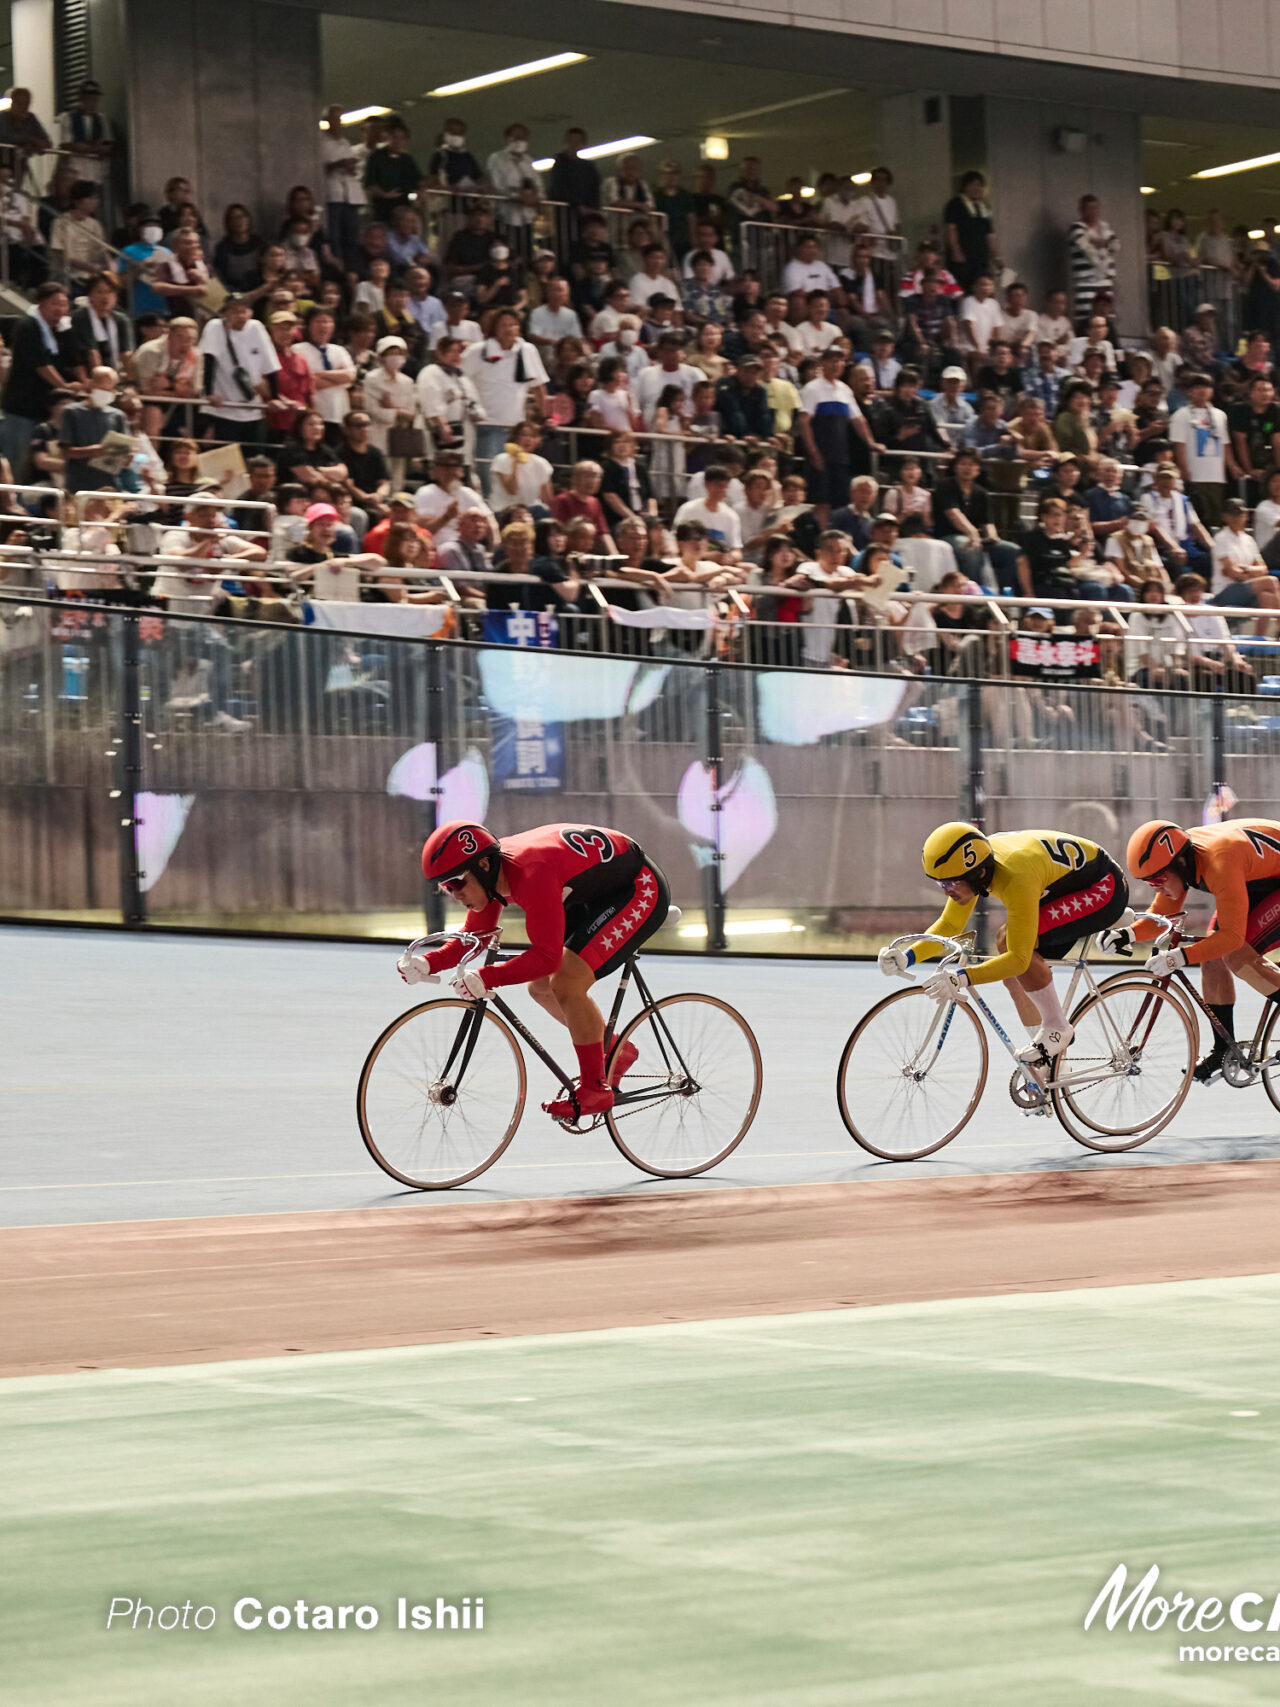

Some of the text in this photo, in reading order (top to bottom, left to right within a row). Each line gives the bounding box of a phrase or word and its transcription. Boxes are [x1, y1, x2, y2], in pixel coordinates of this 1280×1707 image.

[458, 830, 478, 854] 3
[560, 828, 614, 863] 3
[962, 840, 977, 868] 5
[1039, 838, 1086, 871] 5
[1157, 832, 1175, 857] 7
[936, 1001, 957, 1051] MAKINO
